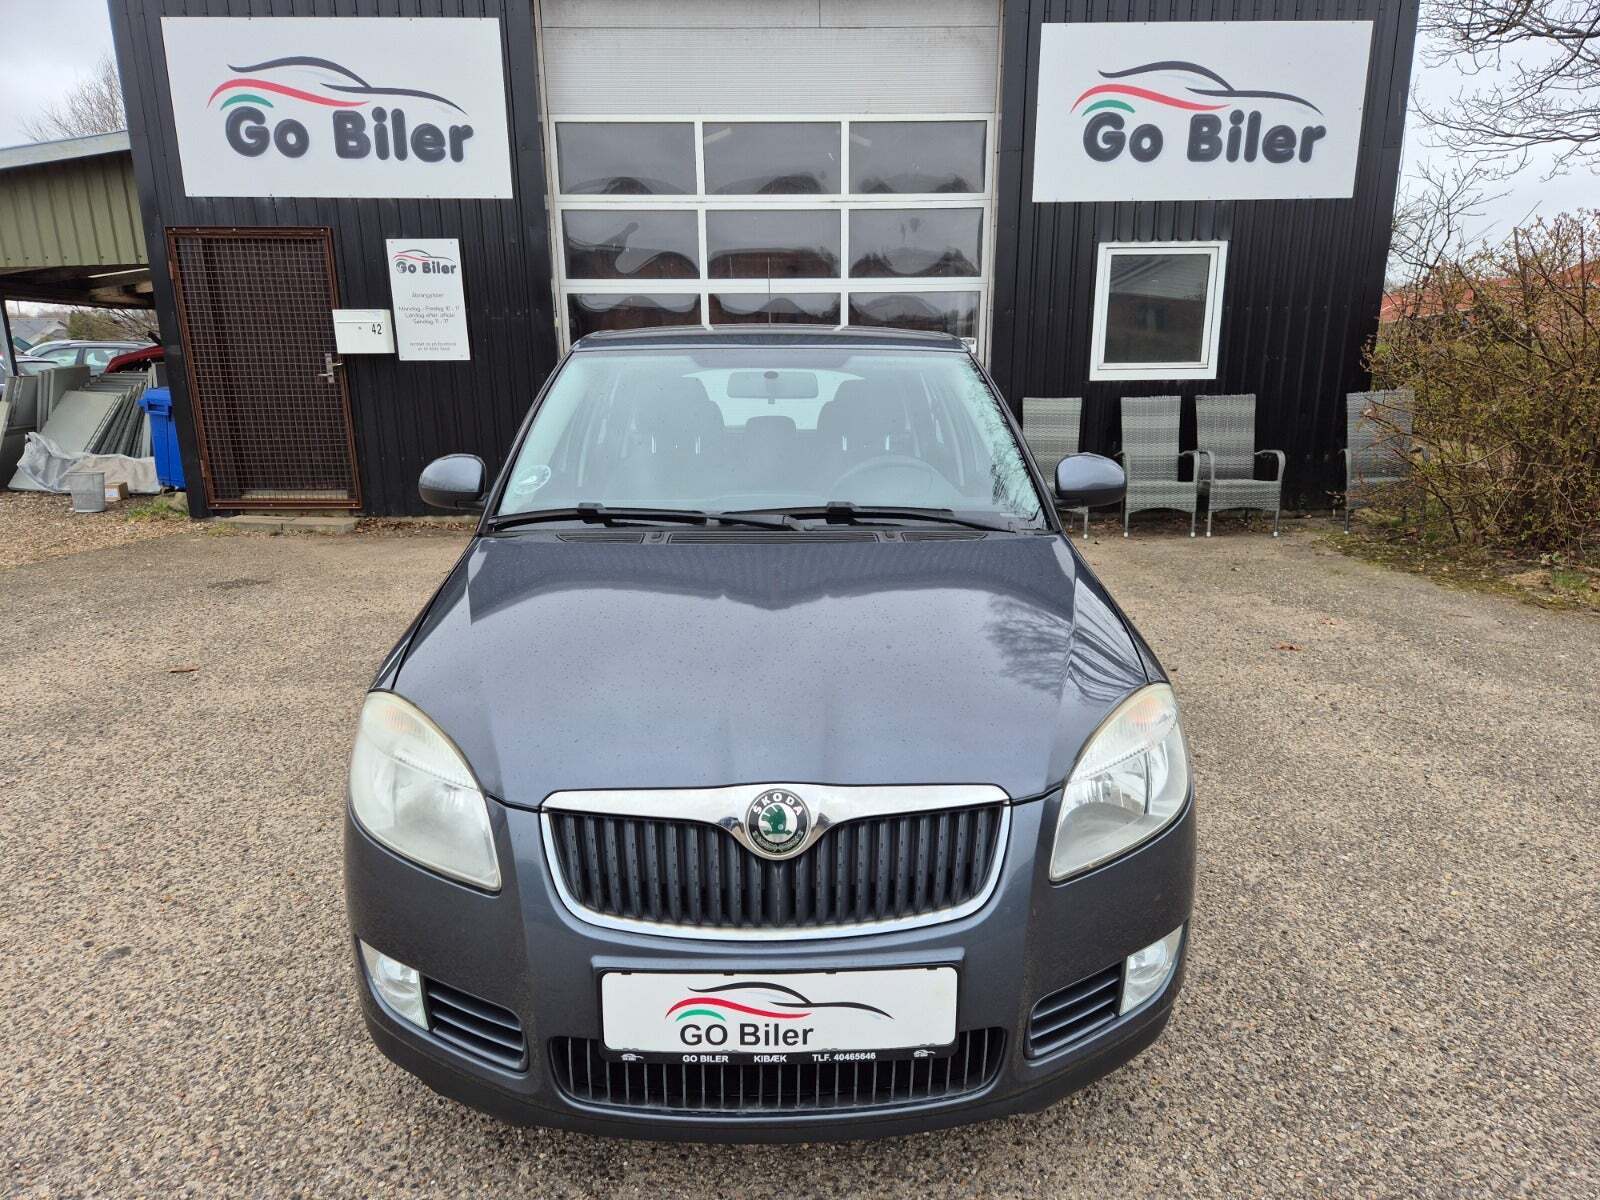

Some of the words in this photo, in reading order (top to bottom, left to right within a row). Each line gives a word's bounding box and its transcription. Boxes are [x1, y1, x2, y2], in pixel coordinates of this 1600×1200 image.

[225, 106, 310, 158] Go
[332, 106, 474, 163] Biler
[1083, 111, 1164, 162] Go
[1186, 109, 1327, 163] Biler
[396, 261, 417, 274] Go
[422, 261, 457, 274] Biler
[371, 323, 383, 335] 42
[679, 1023, 728, 1046] GO
[739, 1022, 814, 1046] Biler
[682, 1055, 698, 1063] GO
[700, 1055, 729, 1063] BILER
[754, 1055, 787, 1063] KIBÆK
[812, 1053, 832, 1062] TLF.
